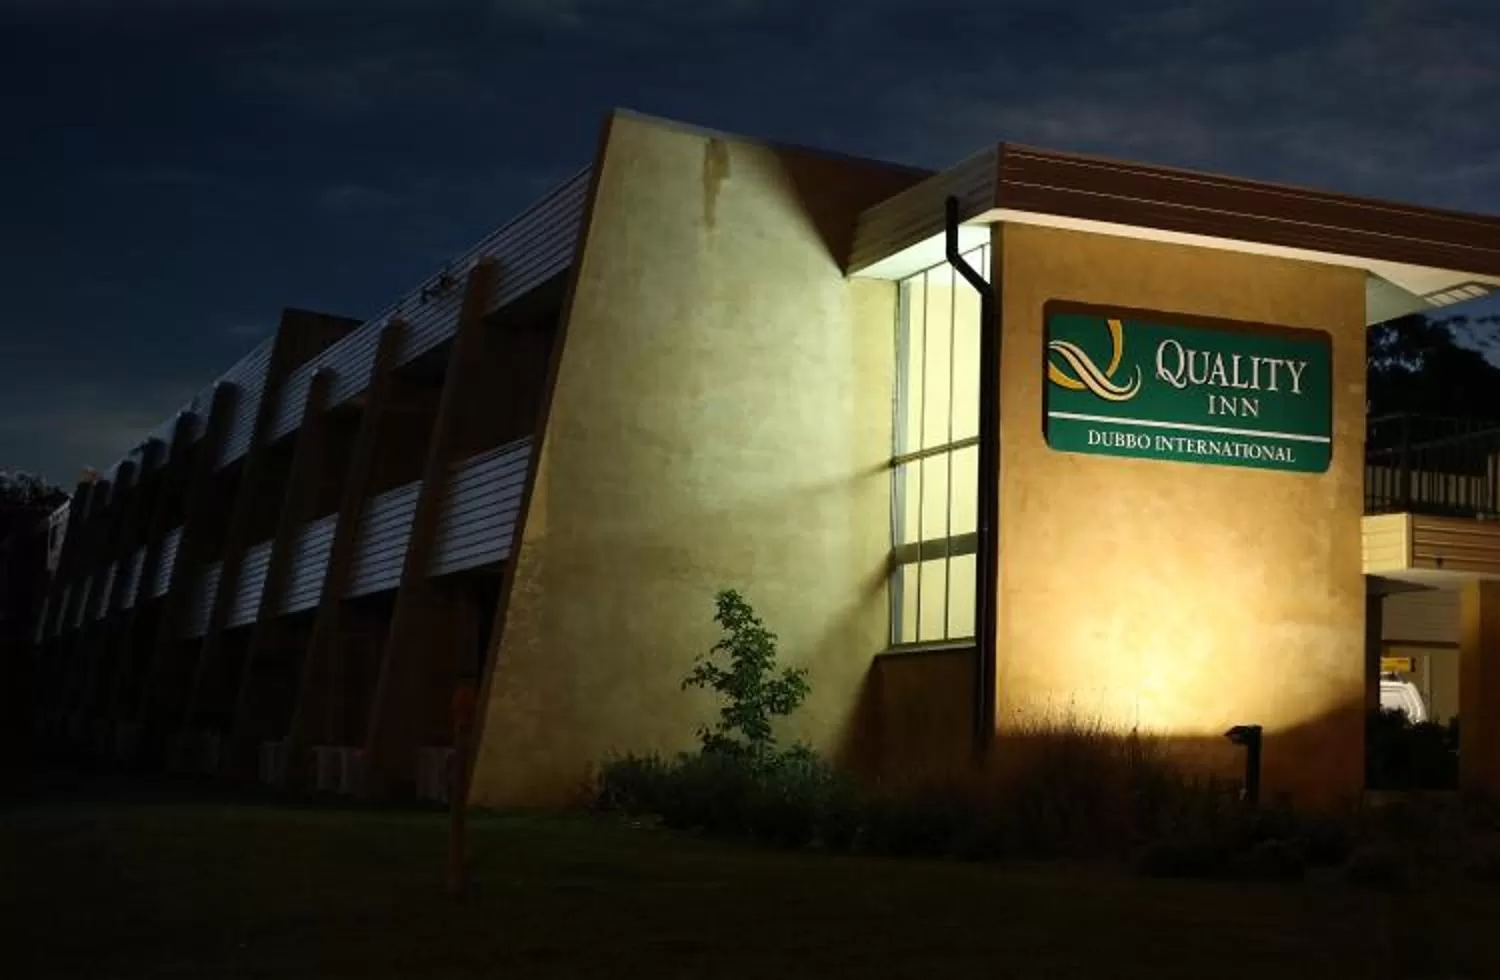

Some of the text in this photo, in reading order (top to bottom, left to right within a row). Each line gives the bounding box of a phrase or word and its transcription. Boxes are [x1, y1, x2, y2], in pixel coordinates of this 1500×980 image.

[1155, 338, 1309, 394] QUALITY
[1208, 395, 1260, 417] INN
[1087, 430, 1296, 463] DUBBO INTERNATIONAL
